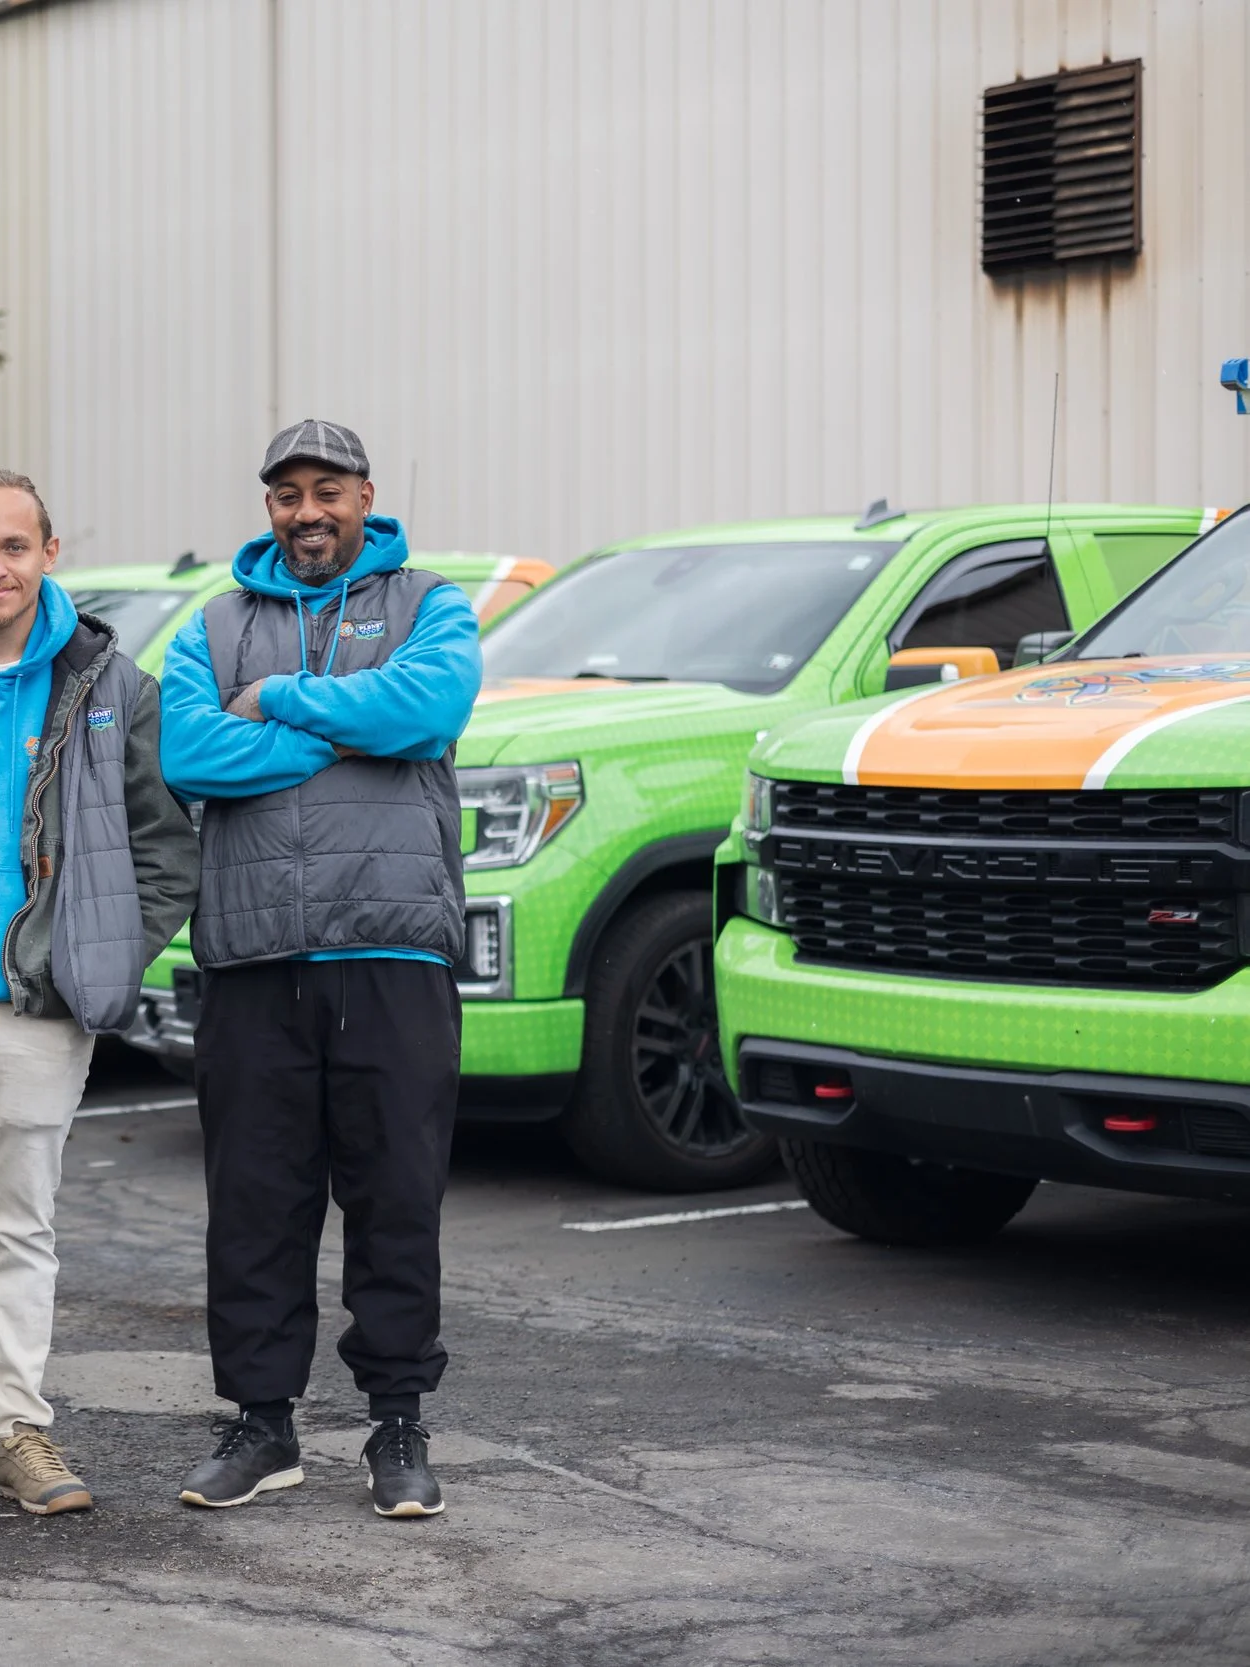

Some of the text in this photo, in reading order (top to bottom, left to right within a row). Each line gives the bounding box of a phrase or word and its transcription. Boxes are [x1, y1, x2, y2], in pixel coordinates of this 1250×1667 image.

[358, 622, 384, 631] PLANET
[88, 709, 112, 718] PLANET
[89, 716, 111, 724] ROOF
[773, 841, 1214, 884] CHEVROLET
